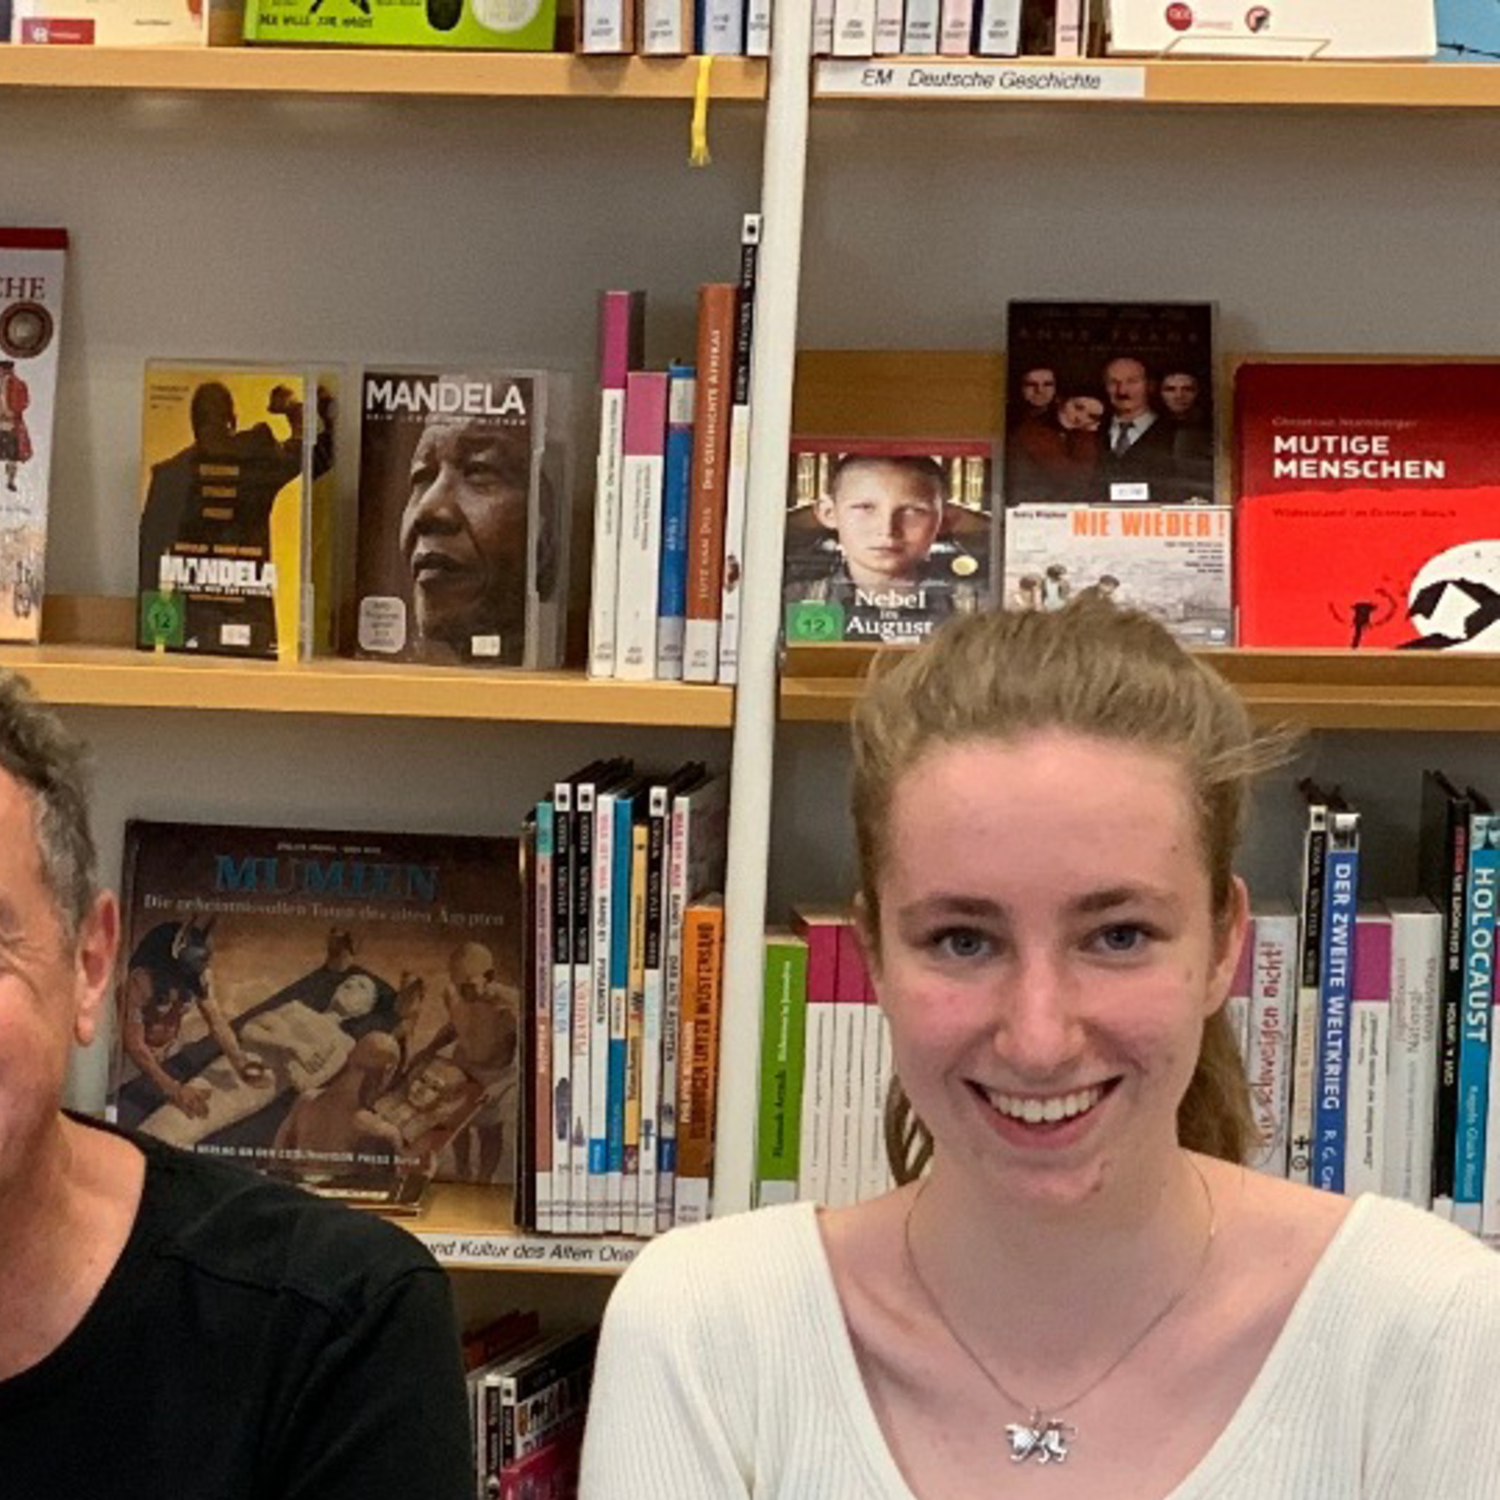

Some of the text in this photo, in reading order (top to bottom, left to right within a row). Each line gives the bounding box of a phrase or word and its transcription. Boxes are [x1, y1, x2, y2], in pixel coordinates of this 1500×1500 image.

[861, 69, 1102, 90] EM Deutsche Geschichte
[366, 380, 526, 416] MANDELA
[1273, 434, 1390, 455] MUTIGE
[1273, 458, 1446, 479] MENSCHEN
[1072, 510, 1211, 538] NIE WIEDER
[854, 588, 927, 610] Nebel
[802, 618, 827, 633] 12
[846, 616, 934, 640] August
[215, 854, 439, 901] MUMIEN
[1332, 862, 1351, 906] DER
[143, 893, 173, 910] Die
[1327, 912, 1349, 987] ZWEITE
[1466, 867, 1495, 1043] HOLOCAUST
[1251, 941, 1284, 1105] schweigen nicht!
[1323, 995, 1344, 1110] WELTKRIEG
[460, 1240, 509, 1258] Kultur
[513, 1244, 546, 1259] des
[548, 1243, 594, 1261] Alten
